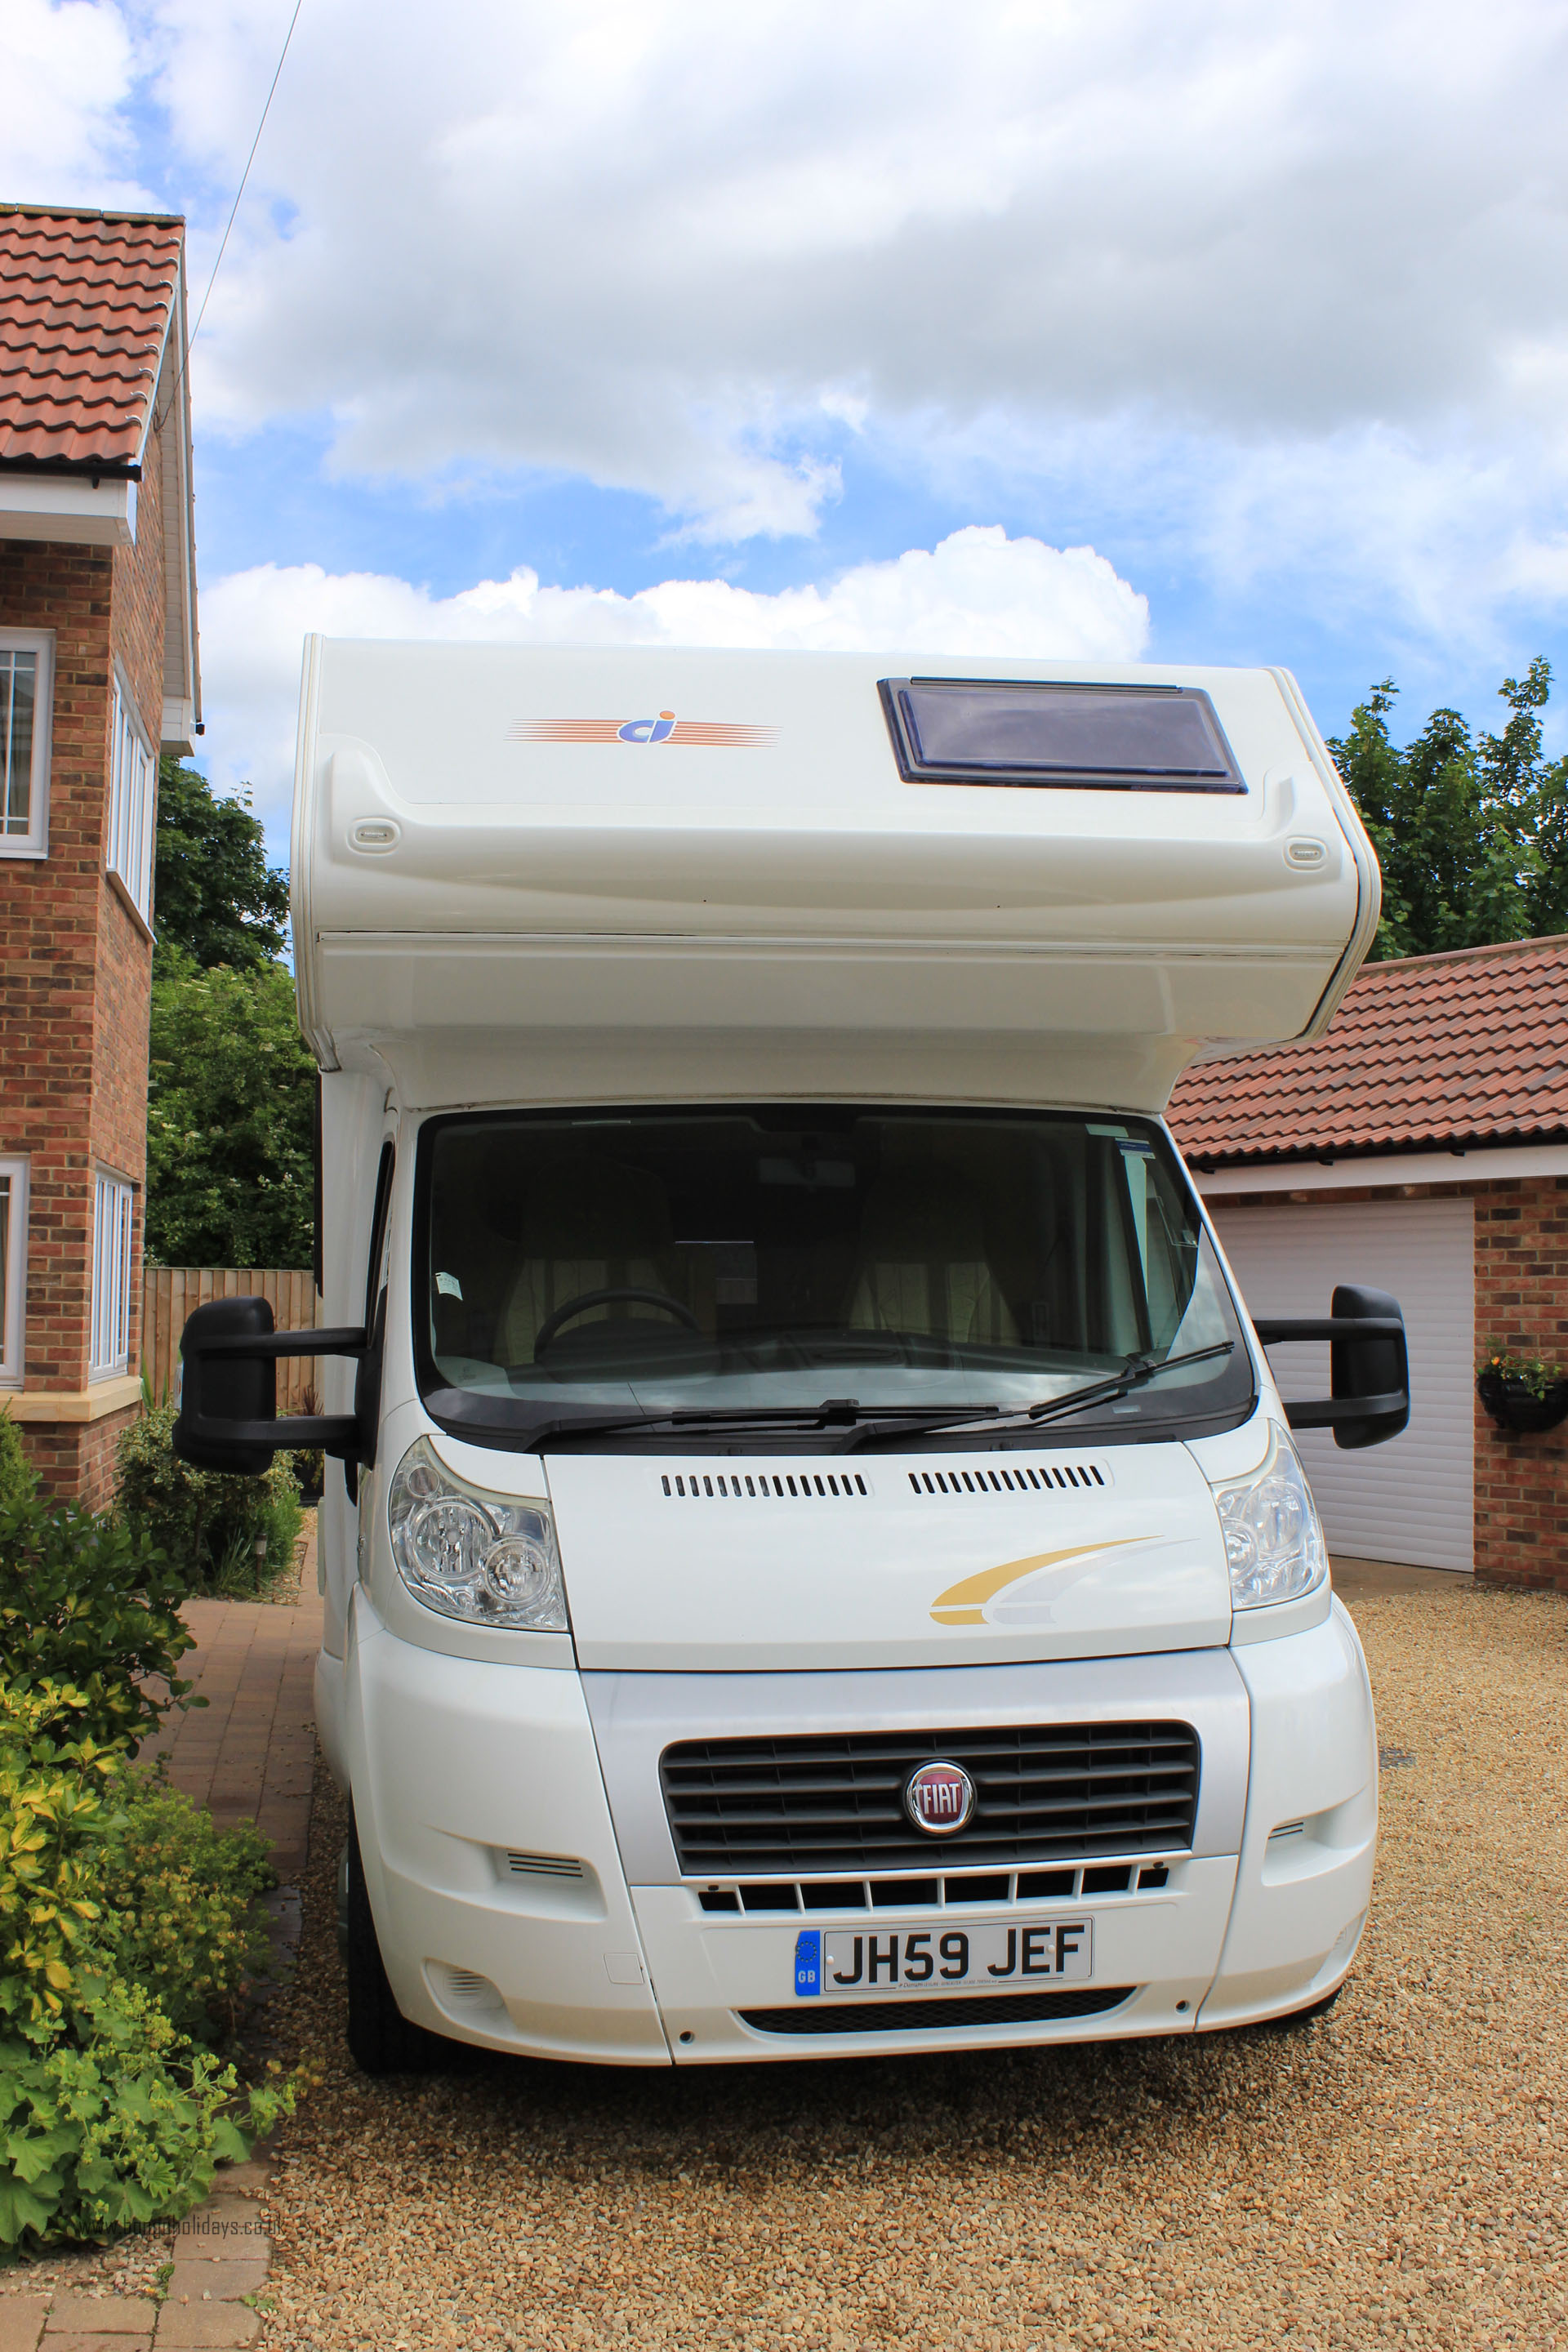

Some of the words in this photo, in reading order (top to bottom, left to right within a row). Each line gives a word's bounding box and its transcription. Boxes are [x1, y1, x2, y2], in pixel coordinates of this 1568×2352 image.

[922, 1783, 960, 1815] FIAT
[832, 1931, 969, 1985] JH59
[987, 1924, 1085, 1977] JEF
[798, 1970, 816, 1984] GB
